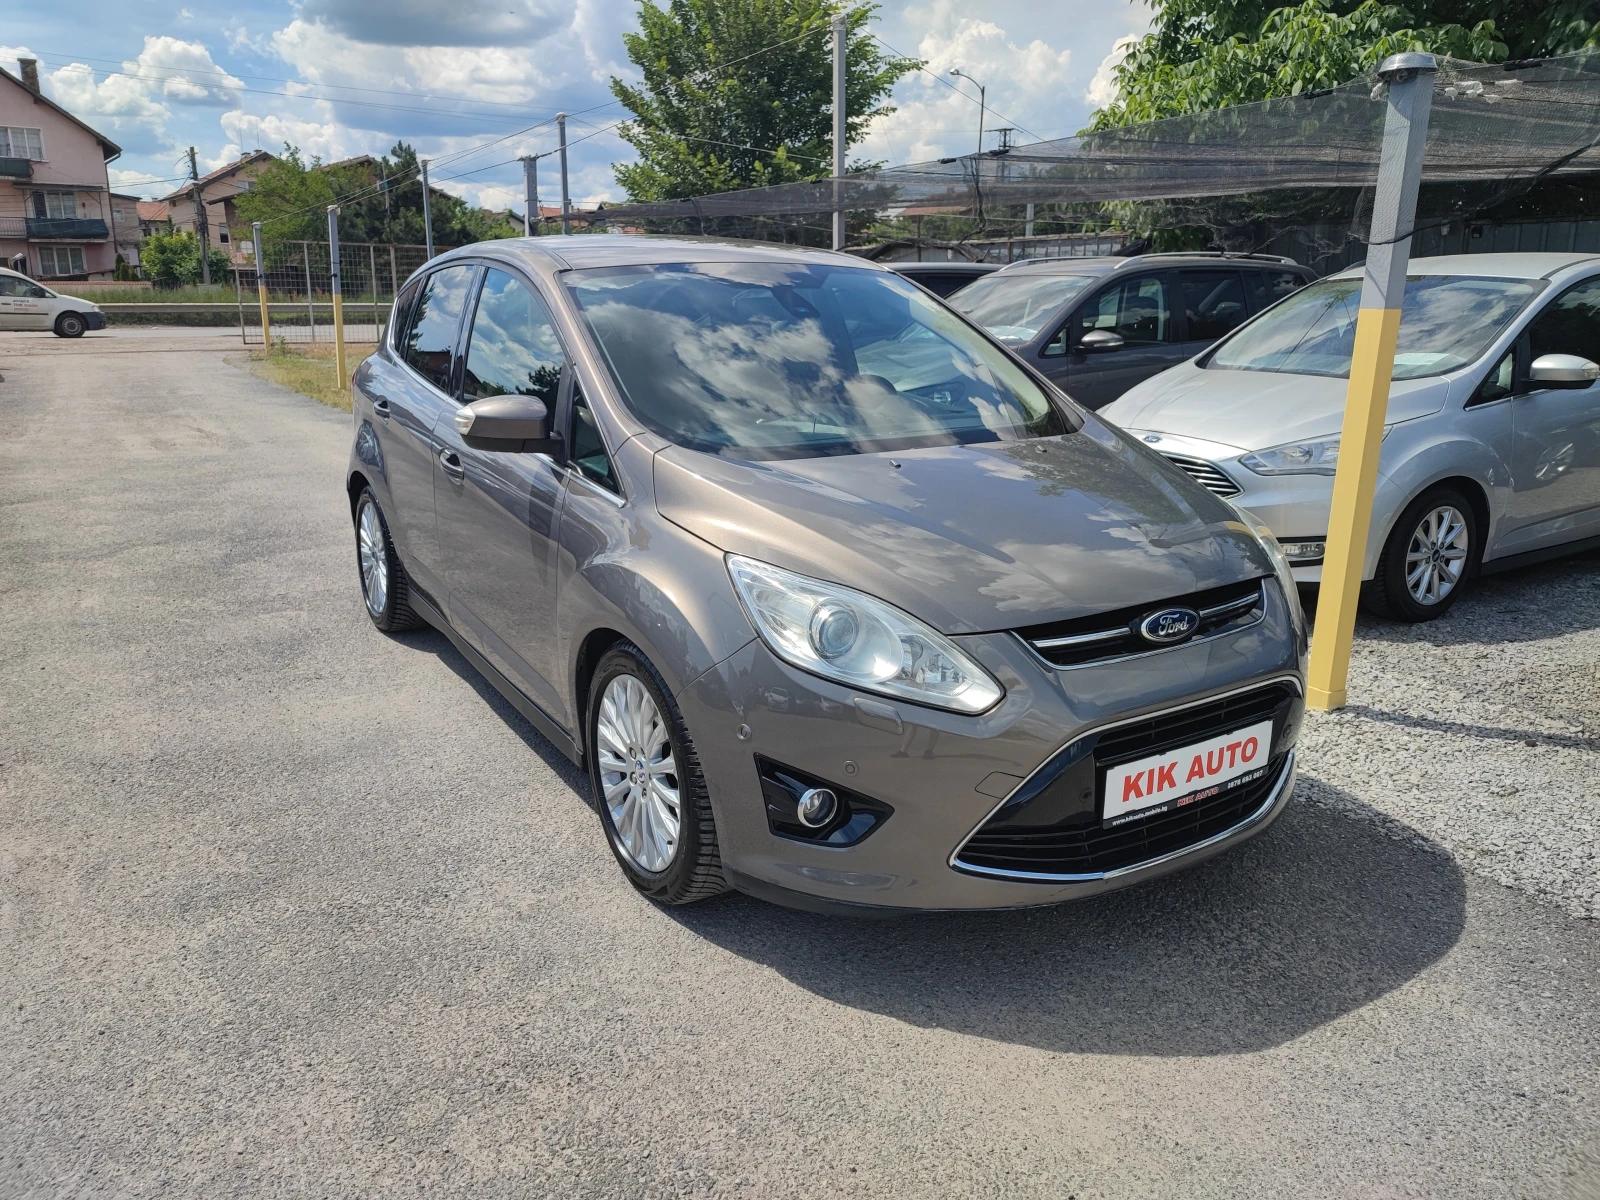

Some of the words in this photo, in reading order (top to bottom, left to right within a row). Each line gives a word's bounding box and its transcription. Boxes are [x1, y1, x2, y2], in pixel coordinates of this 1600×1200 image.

[1159, 613, 1189, 635] Ford
[1122, 761, 1178, 802] KIK
[1185, 736, 1259, 783] AUTO
[1111, 805, 1168, 826] www.kikauto.mobile.bg
[1176, 794, 1195, 808] KIK
[1194, 786, 1219, 801] AUTO
